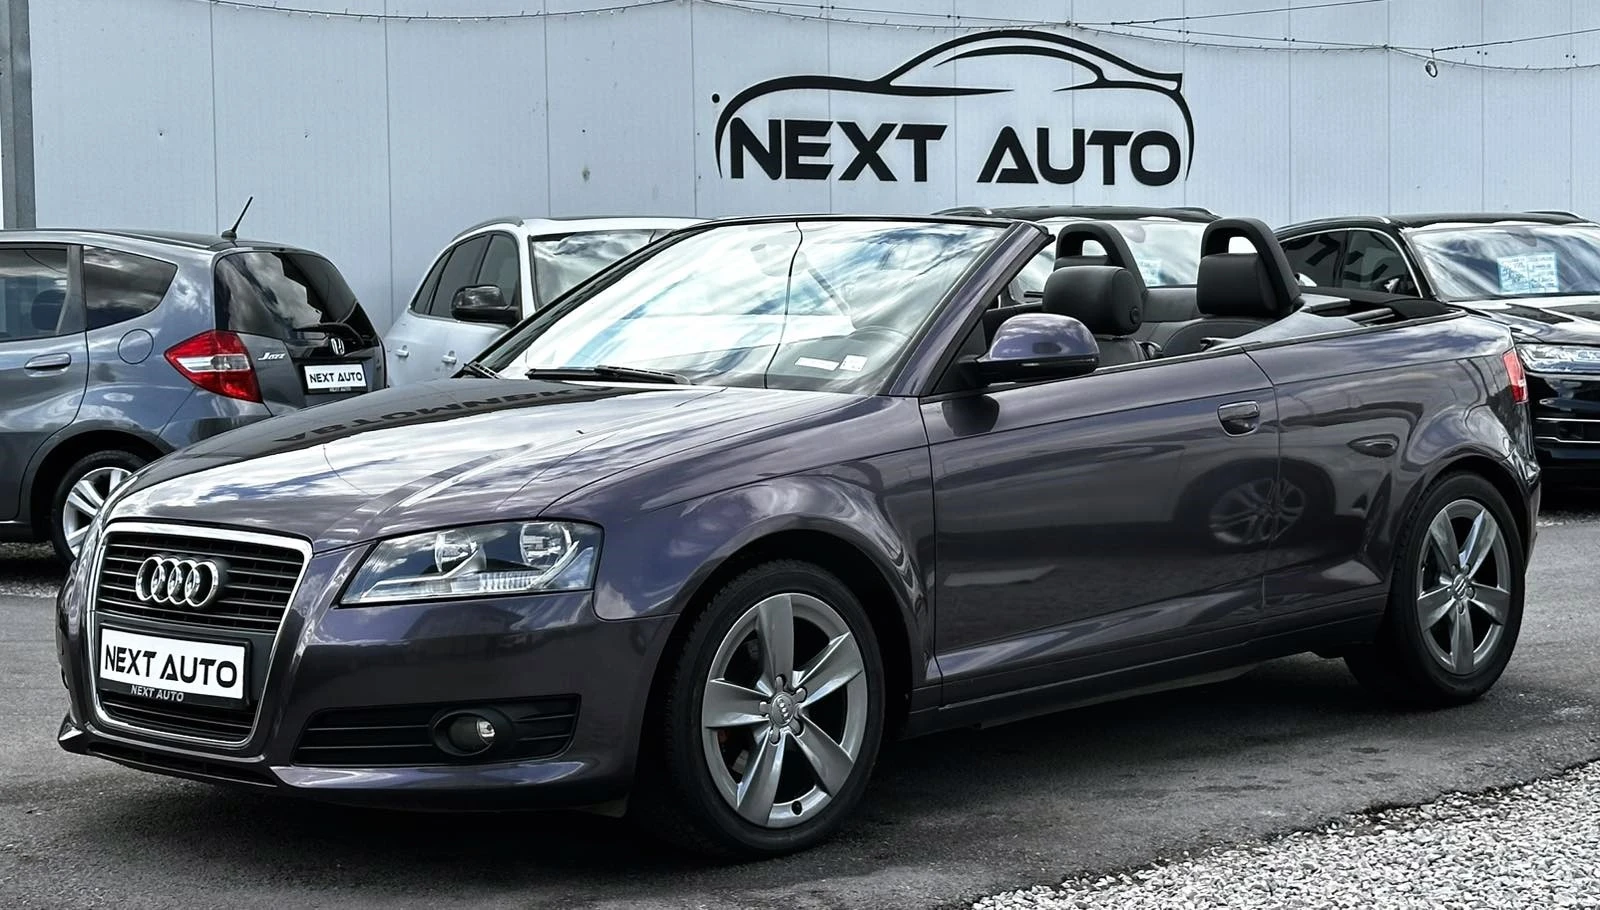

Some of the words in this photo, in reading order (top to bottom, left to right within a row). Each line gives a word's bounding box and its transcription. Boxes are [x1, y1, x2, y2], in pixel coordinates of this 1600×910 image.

[730, 117, 947, 182] NEXT
[977, 126, 1181, 186] AUTO
[309, 373, 334, 383] NEXT
[338, 372, 363, 382] AUTO
[105, 644, 157, 677] NEXT
[160, 654, 238, 688] AUTO
[131, 684, 155, 698] NEXT
[156, 689, 184, 702] AUTO
